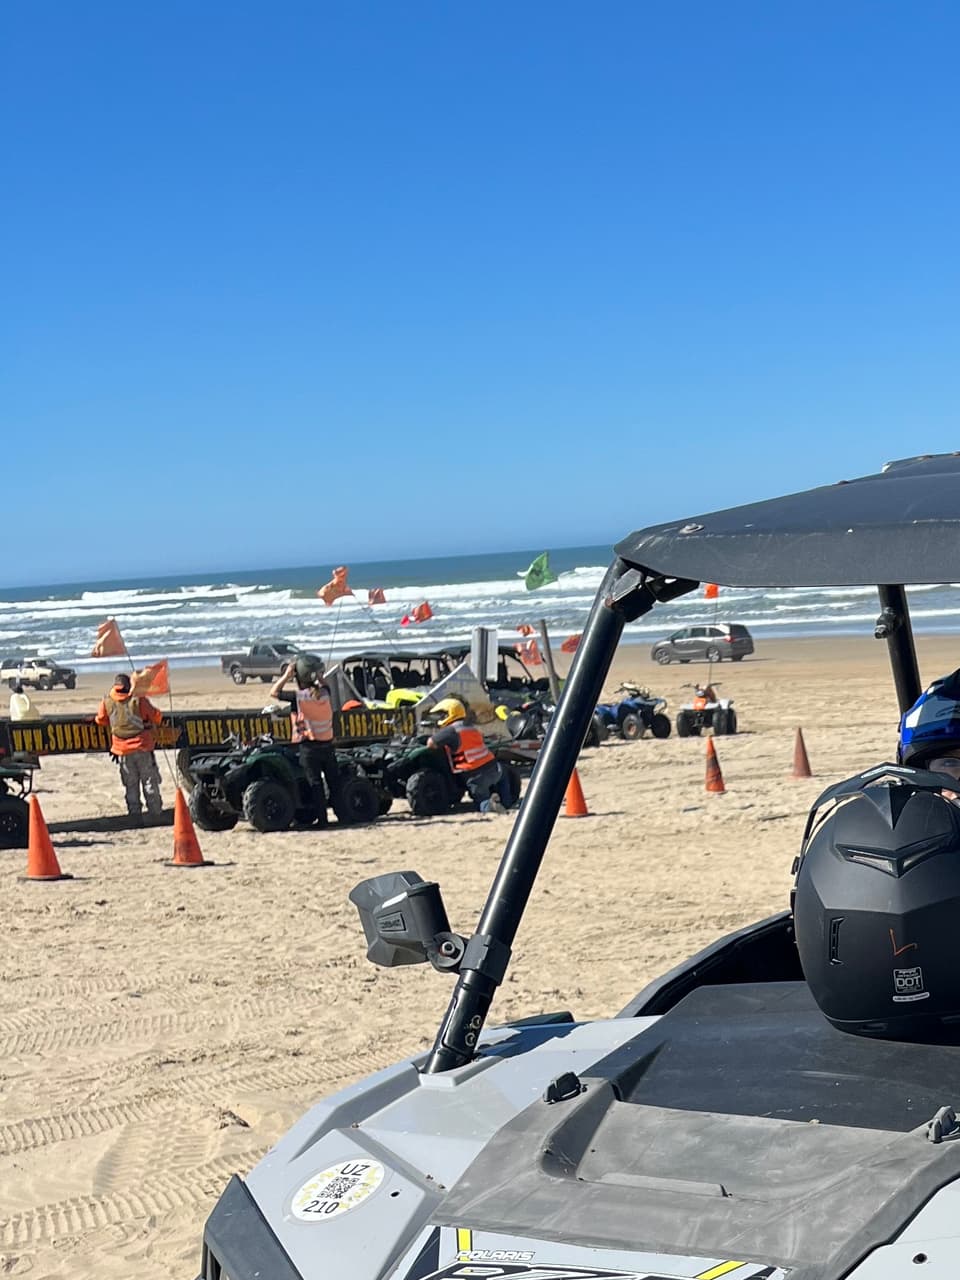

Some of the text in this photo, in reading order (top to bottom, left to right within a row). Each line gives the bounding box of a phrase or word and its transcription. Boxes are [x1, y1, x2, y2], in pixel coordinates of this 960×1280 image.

[12, 723, 112, 753] WWW.SUNBUGG
[896, 976, 921, 987] DOT
[340, 1163, 371, 1177] UZ
[301, 1199, 341, 1215] 210
[456, 1248, 536, 1263] POLARIS
